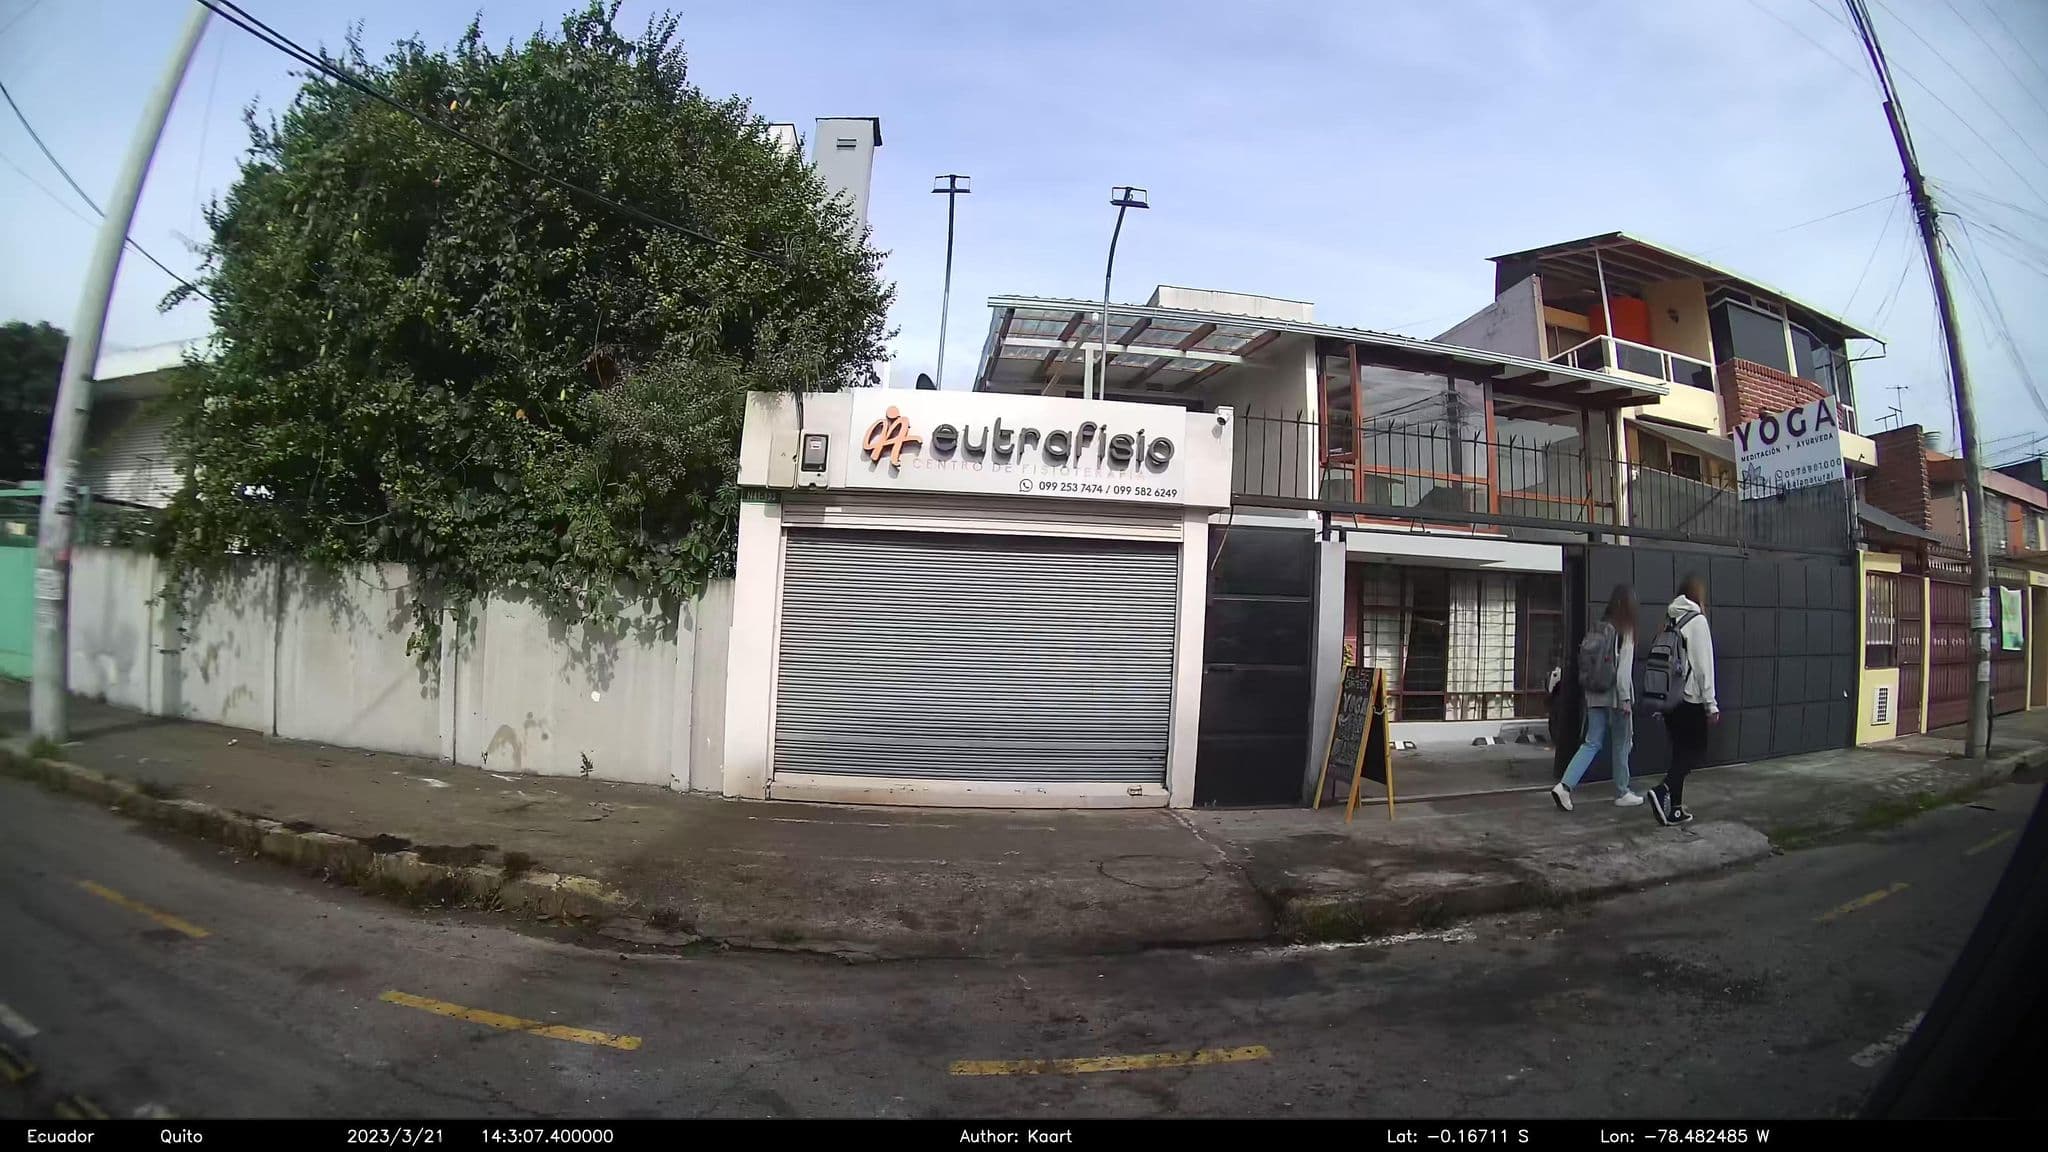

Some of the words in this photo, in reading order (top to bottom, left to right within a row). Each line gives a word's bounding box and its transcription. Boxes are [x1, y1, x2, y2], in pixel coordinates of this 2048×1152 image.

[1734, 399, 1836, 452] YOGA
[931, 417, 1175, 468] eutrafisio
[1796, 432, 1834, 448] AYURVEDA
[912, 458, 984, 472] CENTRO
[992, 462, 1013, 473] DE
[1039, 481, 1058, 491] 099
[1060, 482, 1078, 492] 253
[1081, 483, 1103, 494] 7474
[1105, 485, 1111, 494] /
[1113, 485, 1132, 496] 099
[1134, 486, 1152, 497] 582
[1154, 487, 1178, 498] 6249
